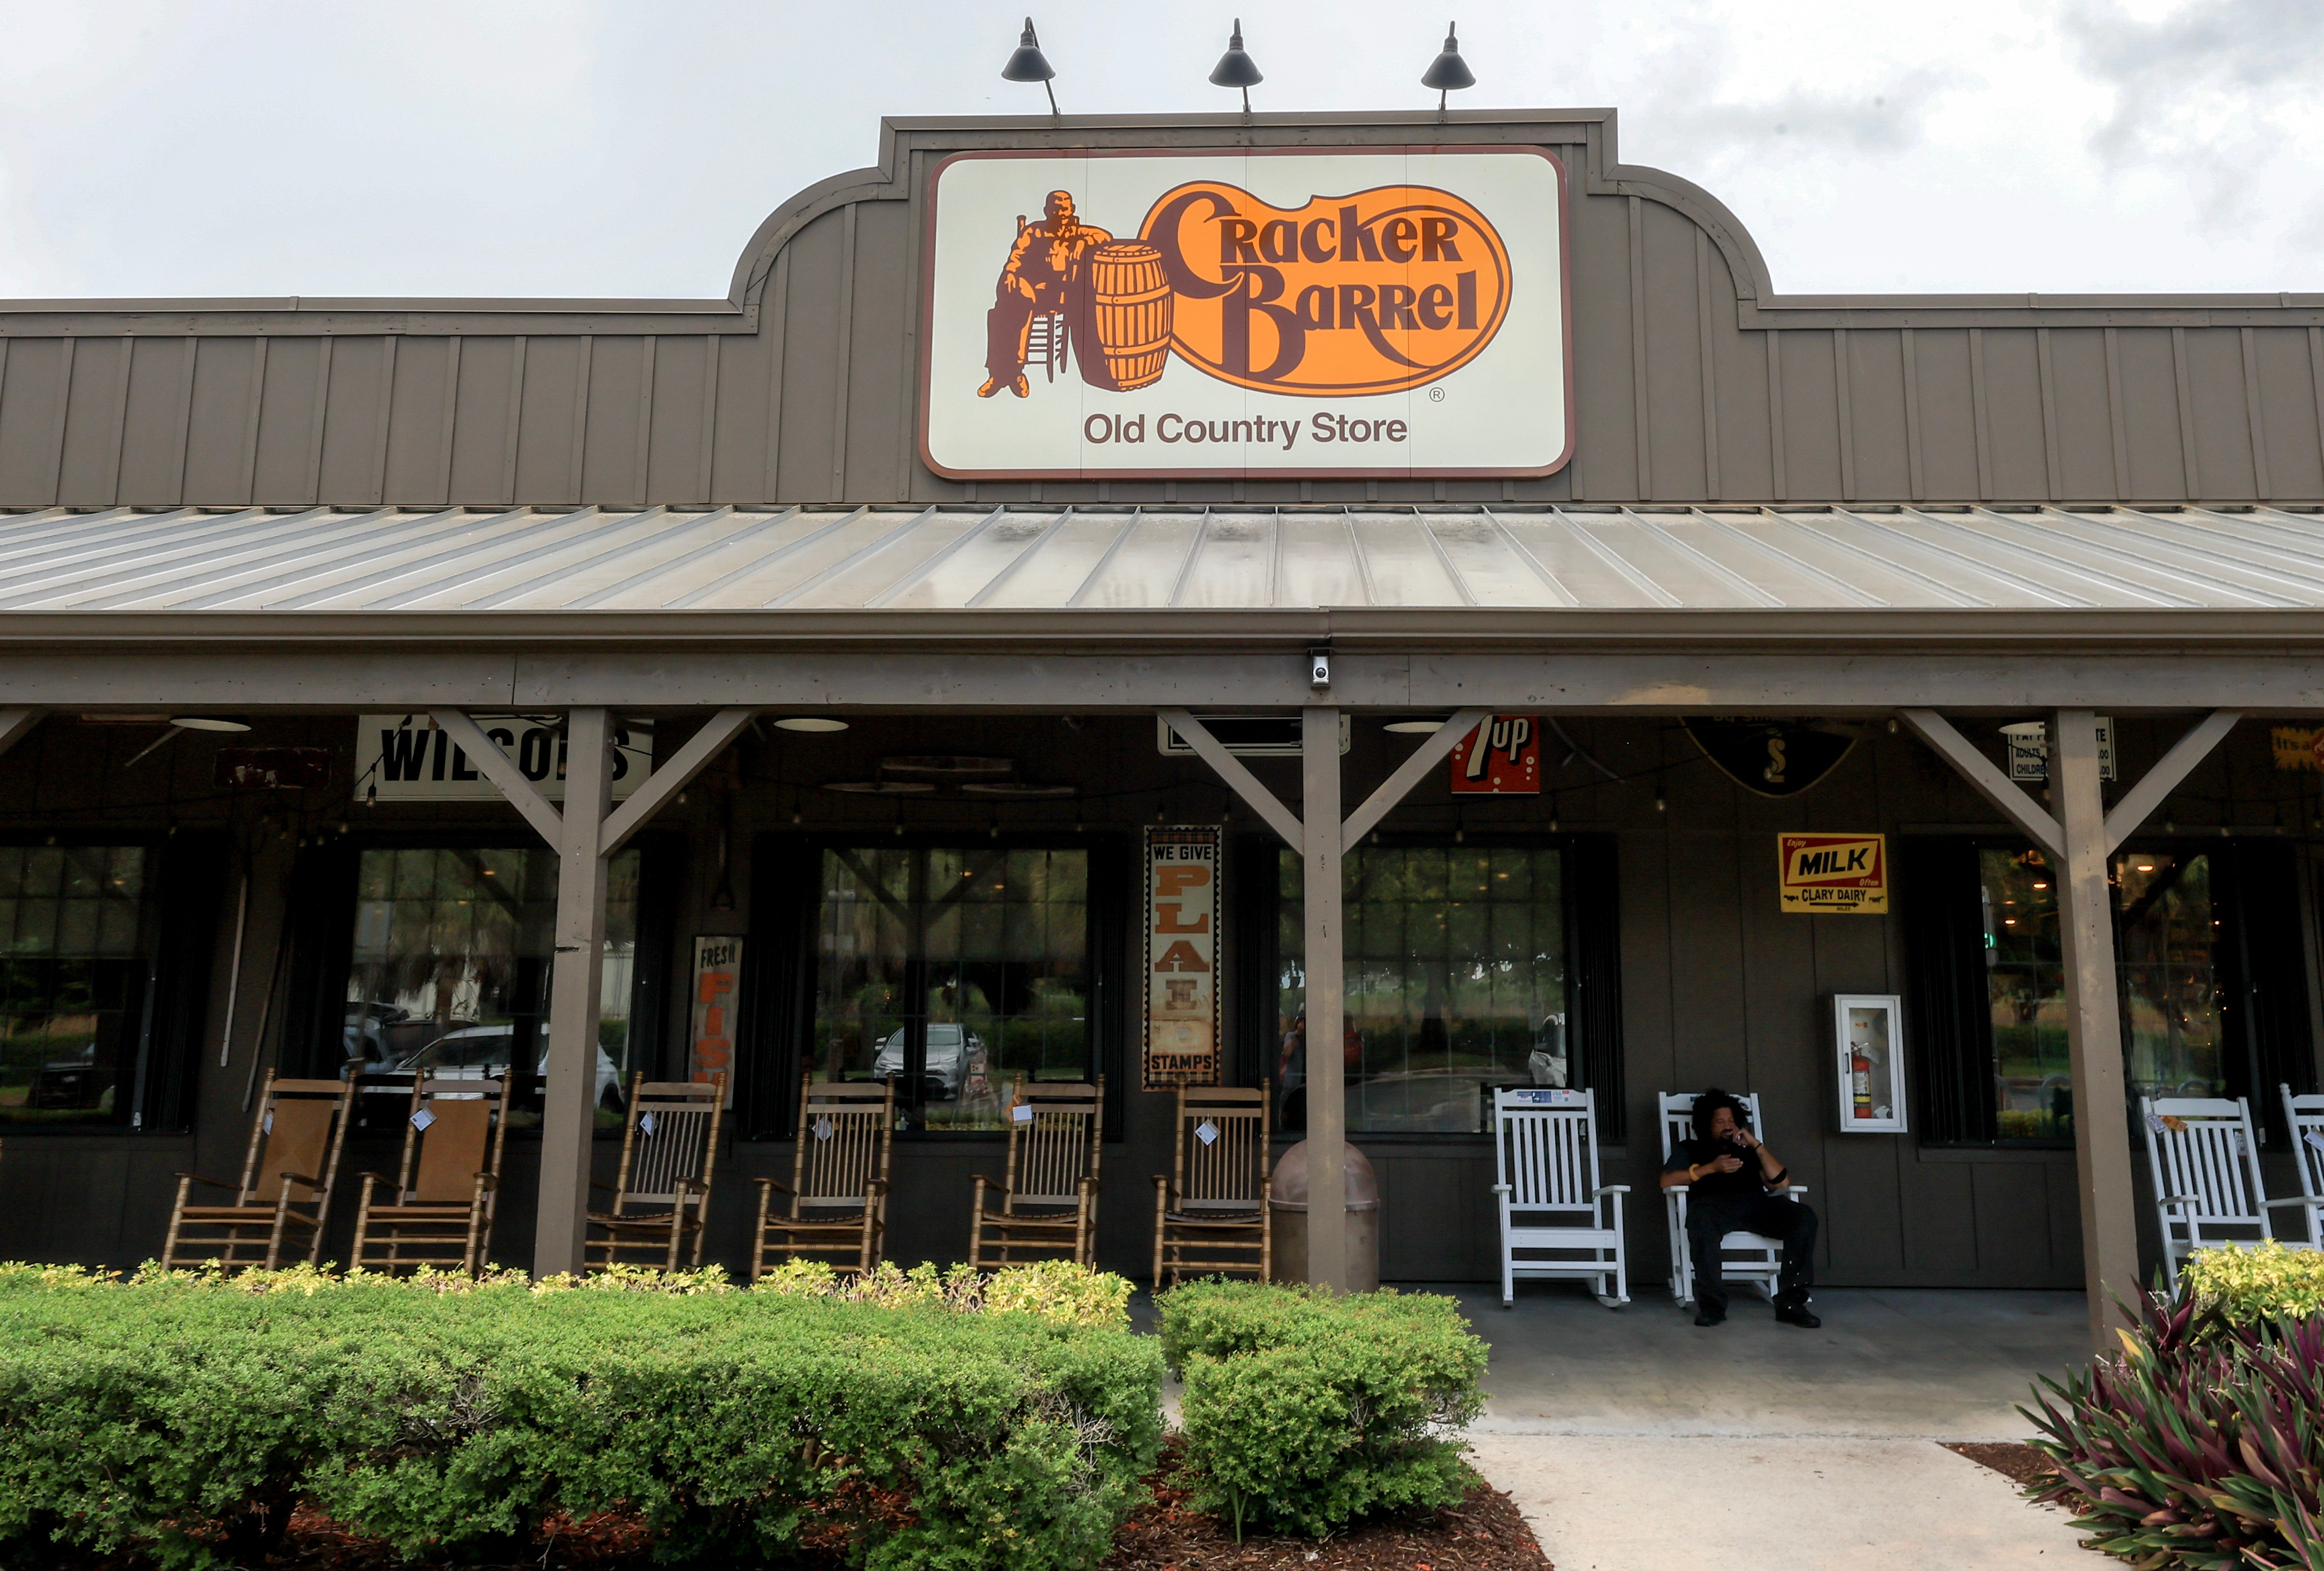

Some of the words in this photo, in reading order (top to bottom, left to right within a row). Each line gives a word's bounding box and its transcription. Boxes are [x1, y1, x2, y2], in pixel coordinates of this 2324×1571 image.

[1147, 191, 1461, 299] Cracker
[1220, 265, 1480, 381] Barrel
[1084, 414, 1145, 444] Old
[1157, 414, 1301, 450] Country
[1312, 412, 1407, 442] Store
[2017, 764, 2046, 774] CHILDRE
[1153, 846, 1174, 860] WE
[1179, 846, 1212, 860] GIVE
[1787, 839, 1807, 848] Enjoy
[1799, 847, 1869, 876] MILK
[1859, 878, 1879, 887] Often
[1802, 889, 1834, 902] CLARY
[1837, 889, 1867, 902] DAIRY
[700, 944, 736, 969] FRESH
[1154, 865, 1210, 1042] PLAI
[1152, 1055, 1212, 1069] STAMPS
